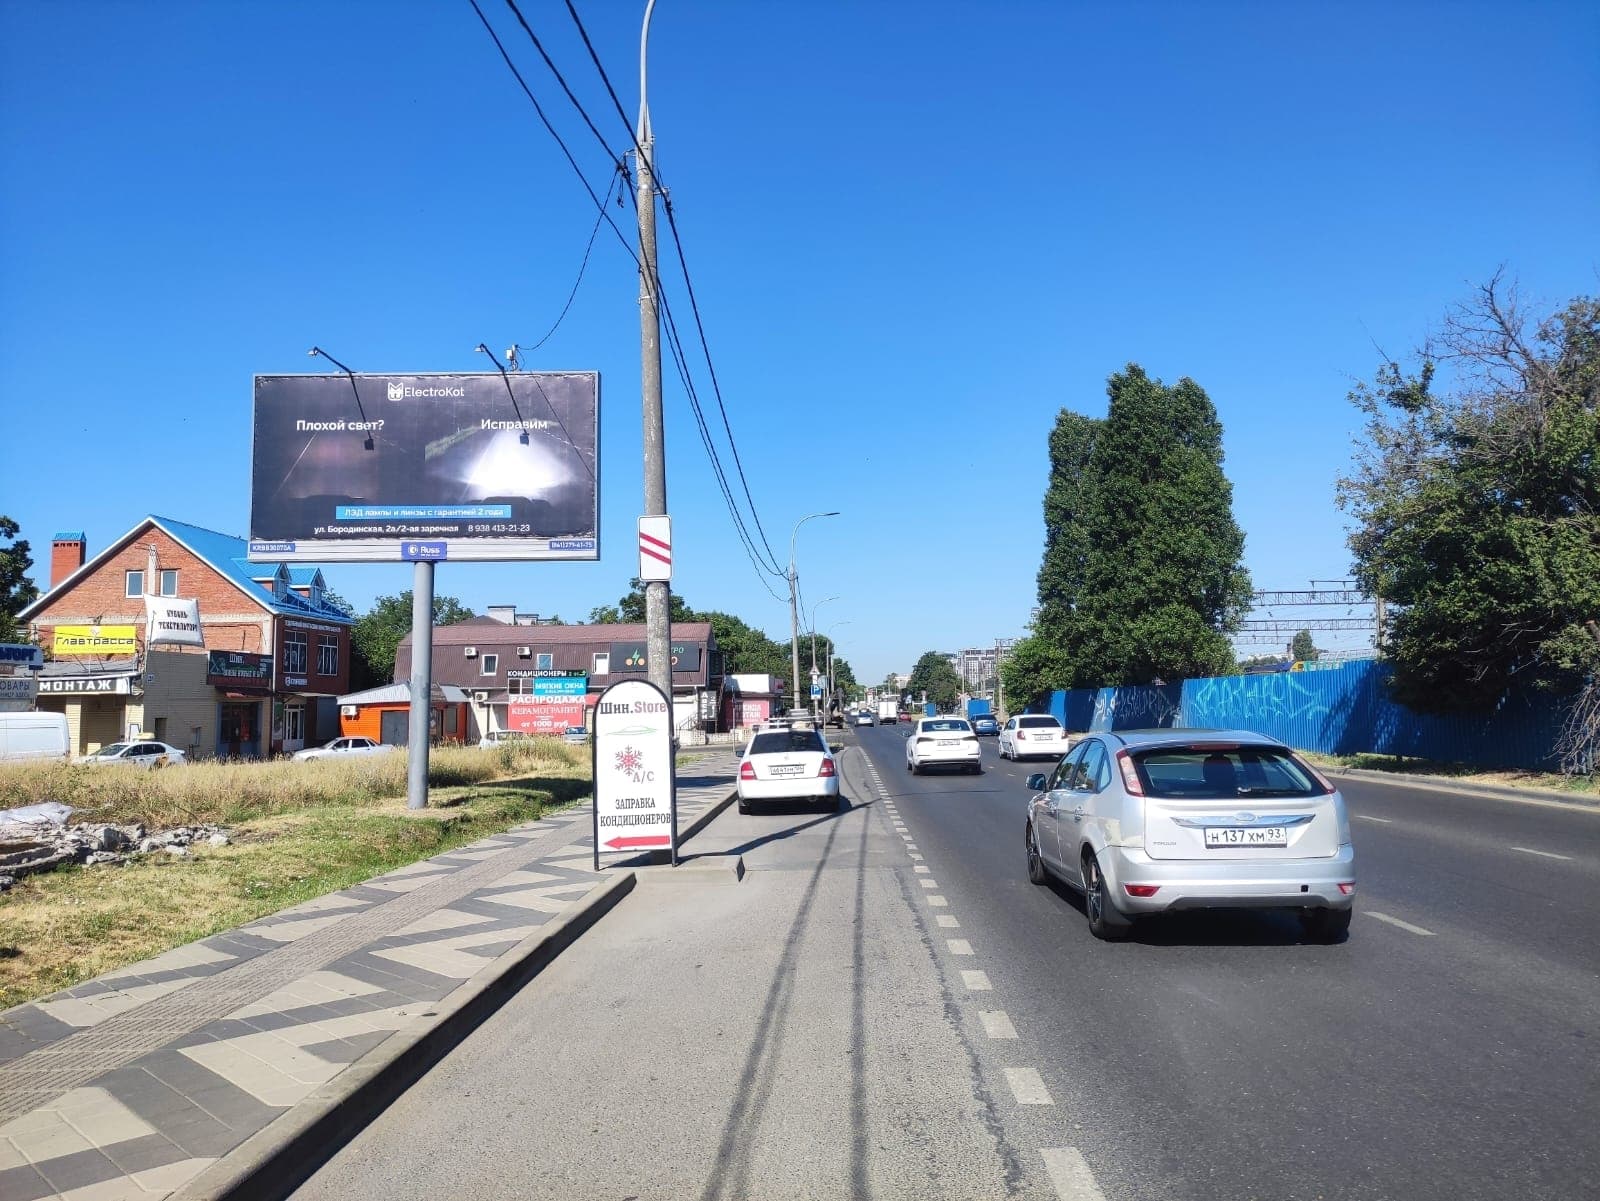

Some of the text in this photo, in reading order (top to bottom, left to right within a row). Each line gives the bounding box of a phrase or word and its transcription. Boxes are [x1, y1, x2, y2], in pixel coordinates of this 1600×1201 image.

[404, 386, 465, 398] ElectroKot
[296, 419, 385, 431] Плохой свет?
[481, 418, 548, 430] Исправим
[344, 508, 363, 517] ЛЭД
[477, 507, 485, 516] 2
[314, 526, 325, 535] ул.
[327, 525, 385, 535] Бородинская,
[491, 523, 530, 532] 413-21-23
[420, 546, 440, 554] Russ
[55, 636, 134, 646] Главтрасса
[39, 679, 112, 691] МОНТАЖ
[535, 682, 563, 690] МЯГКИЕ
[510, 695, 586, 705] РАСПРОДАЖА
[511, 706, 577, 715] КЕРАМОГРАНИТ
[632, 770, 655, 784] A/C
[615, 797, 656, 810] ЗАПРАВКА
[600, 812, 671, 828] КОНДИЦИОНЕРОВ
